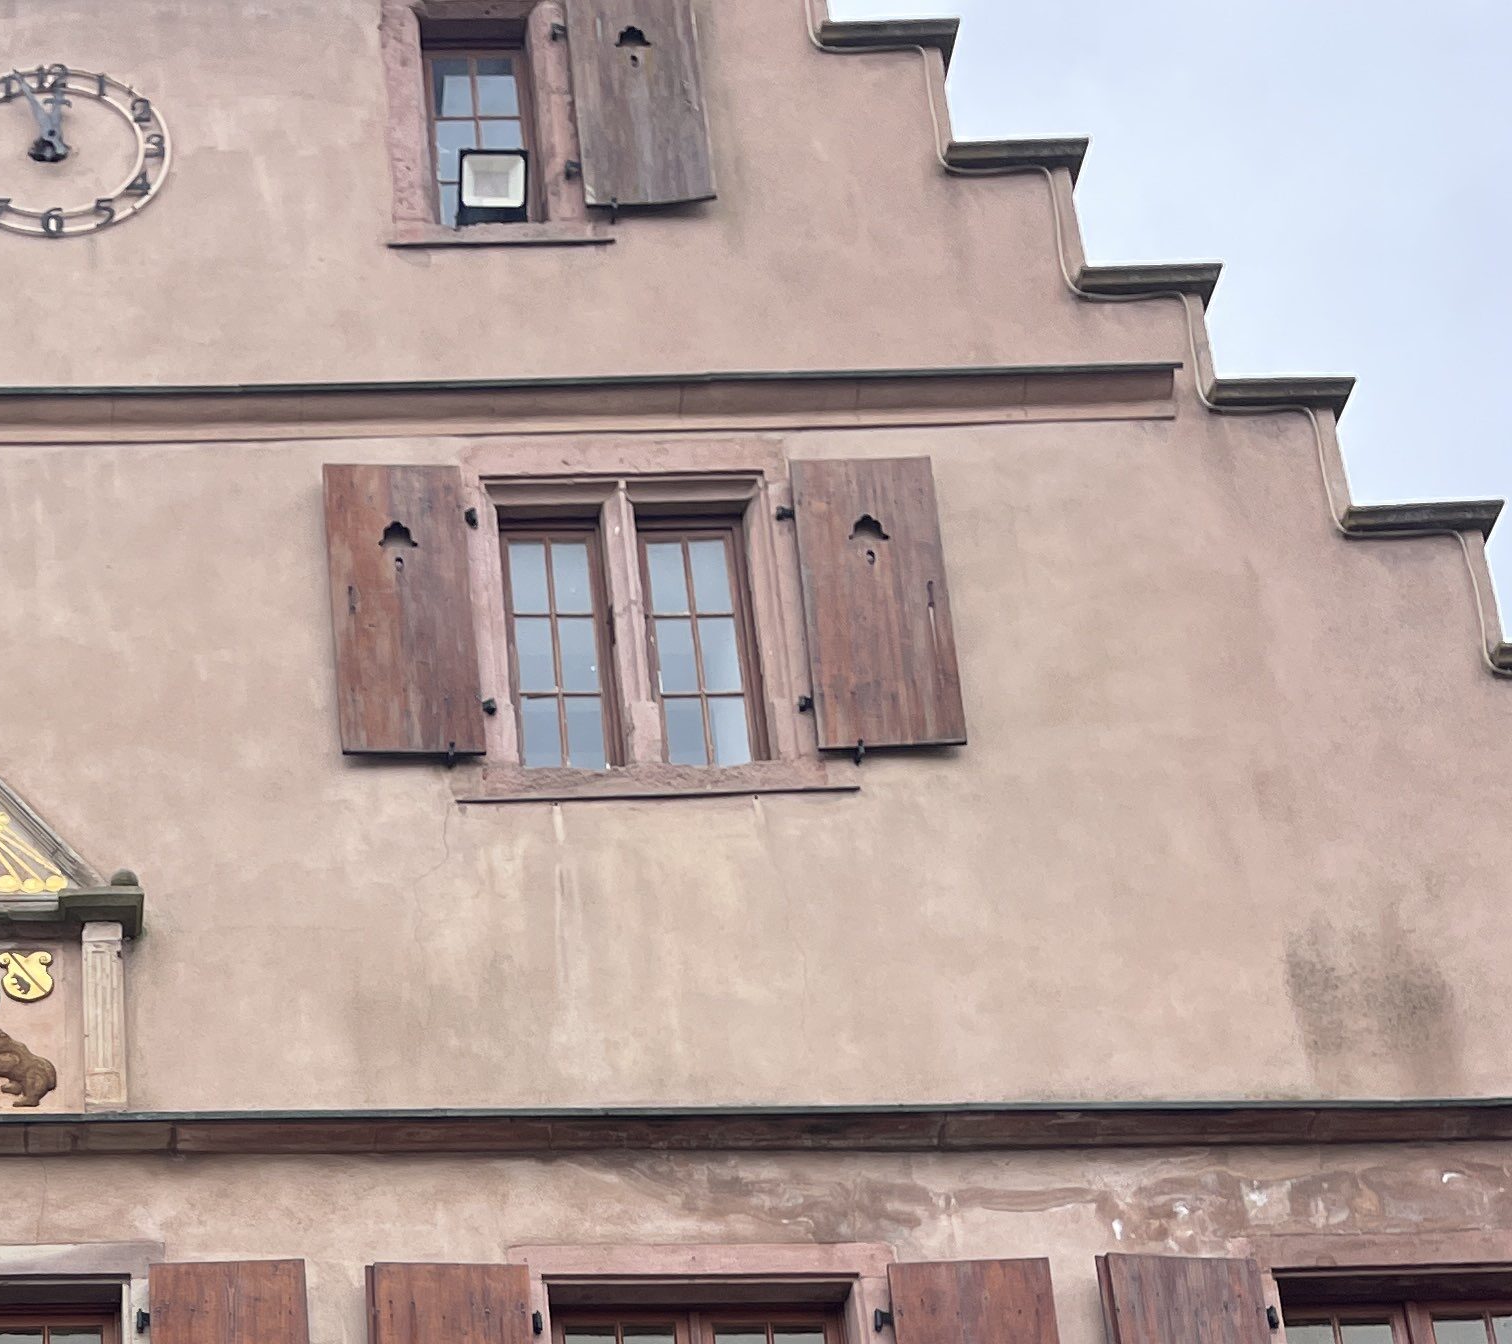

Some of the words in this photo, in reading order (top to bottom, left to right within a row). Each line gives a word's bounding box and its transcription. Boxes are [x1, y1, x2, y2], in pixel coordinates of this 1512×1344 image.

[37, 63, 69, 89] 12
[96, 73, 106, 97] 1
[130, 98, 151, 122] 2
[144, 134, 165, 158] 3
[125, 171, 151, 196] 4
[41, 208, 64, 236] 6
[94, 198, 115, 227] 5
